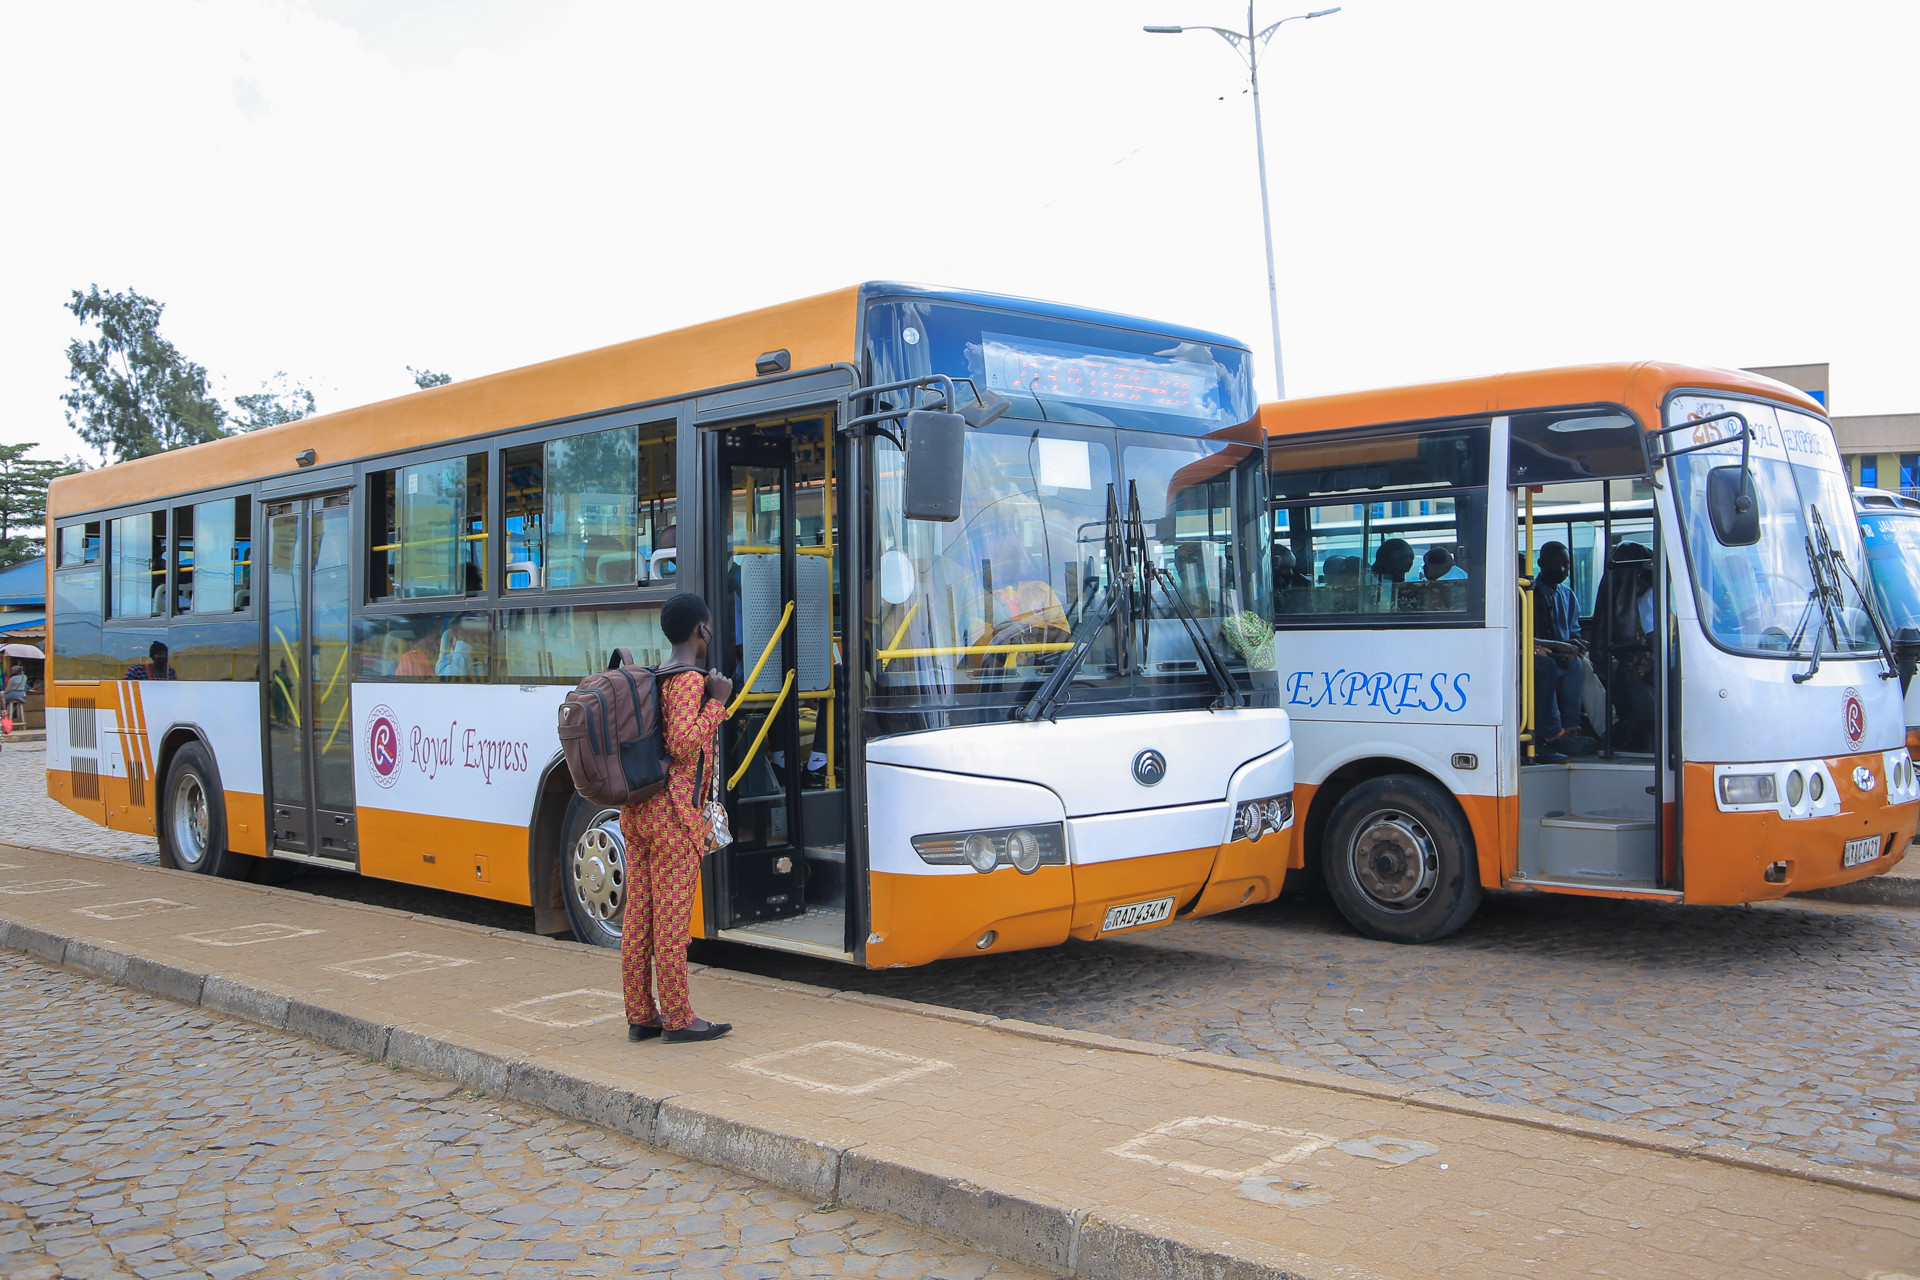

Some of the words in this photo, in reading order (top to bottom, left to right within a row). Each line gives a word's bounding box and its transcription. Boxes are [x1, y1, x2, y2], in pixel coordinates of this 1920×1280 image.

[1286, 669, 1471, 715] EXPRESS
[410, 720, 457, 780] Royal
[462, 728, 529, 785] Express
